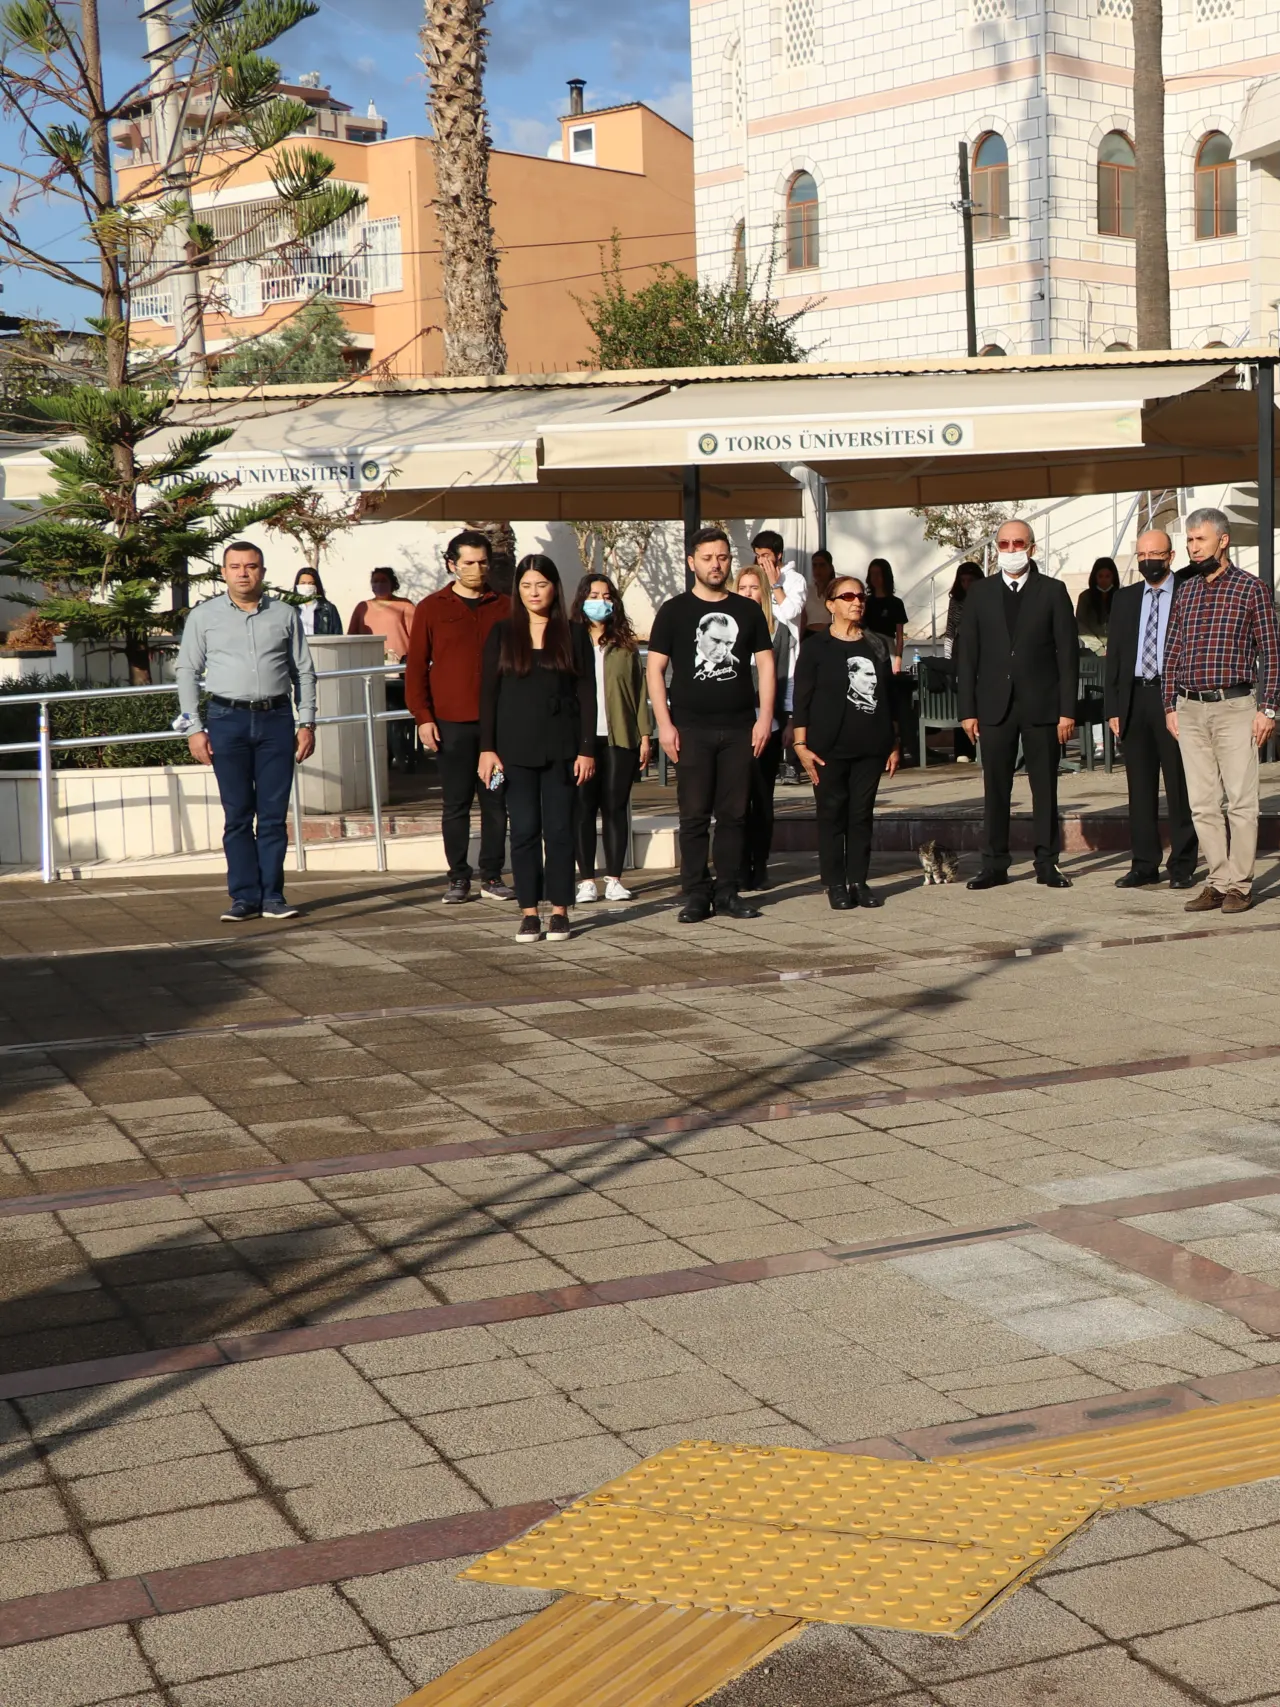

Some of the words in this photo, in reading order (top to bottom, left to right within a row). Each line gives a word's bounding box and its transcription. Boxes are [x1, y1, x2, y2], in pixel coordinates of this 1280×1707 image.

[725, 433, 792, 452] TOROS
[799, 425, 934, 450] ÜNİVERSİTESİ
[235, 462, 356, 483] ÜNİVERSİTESİ
